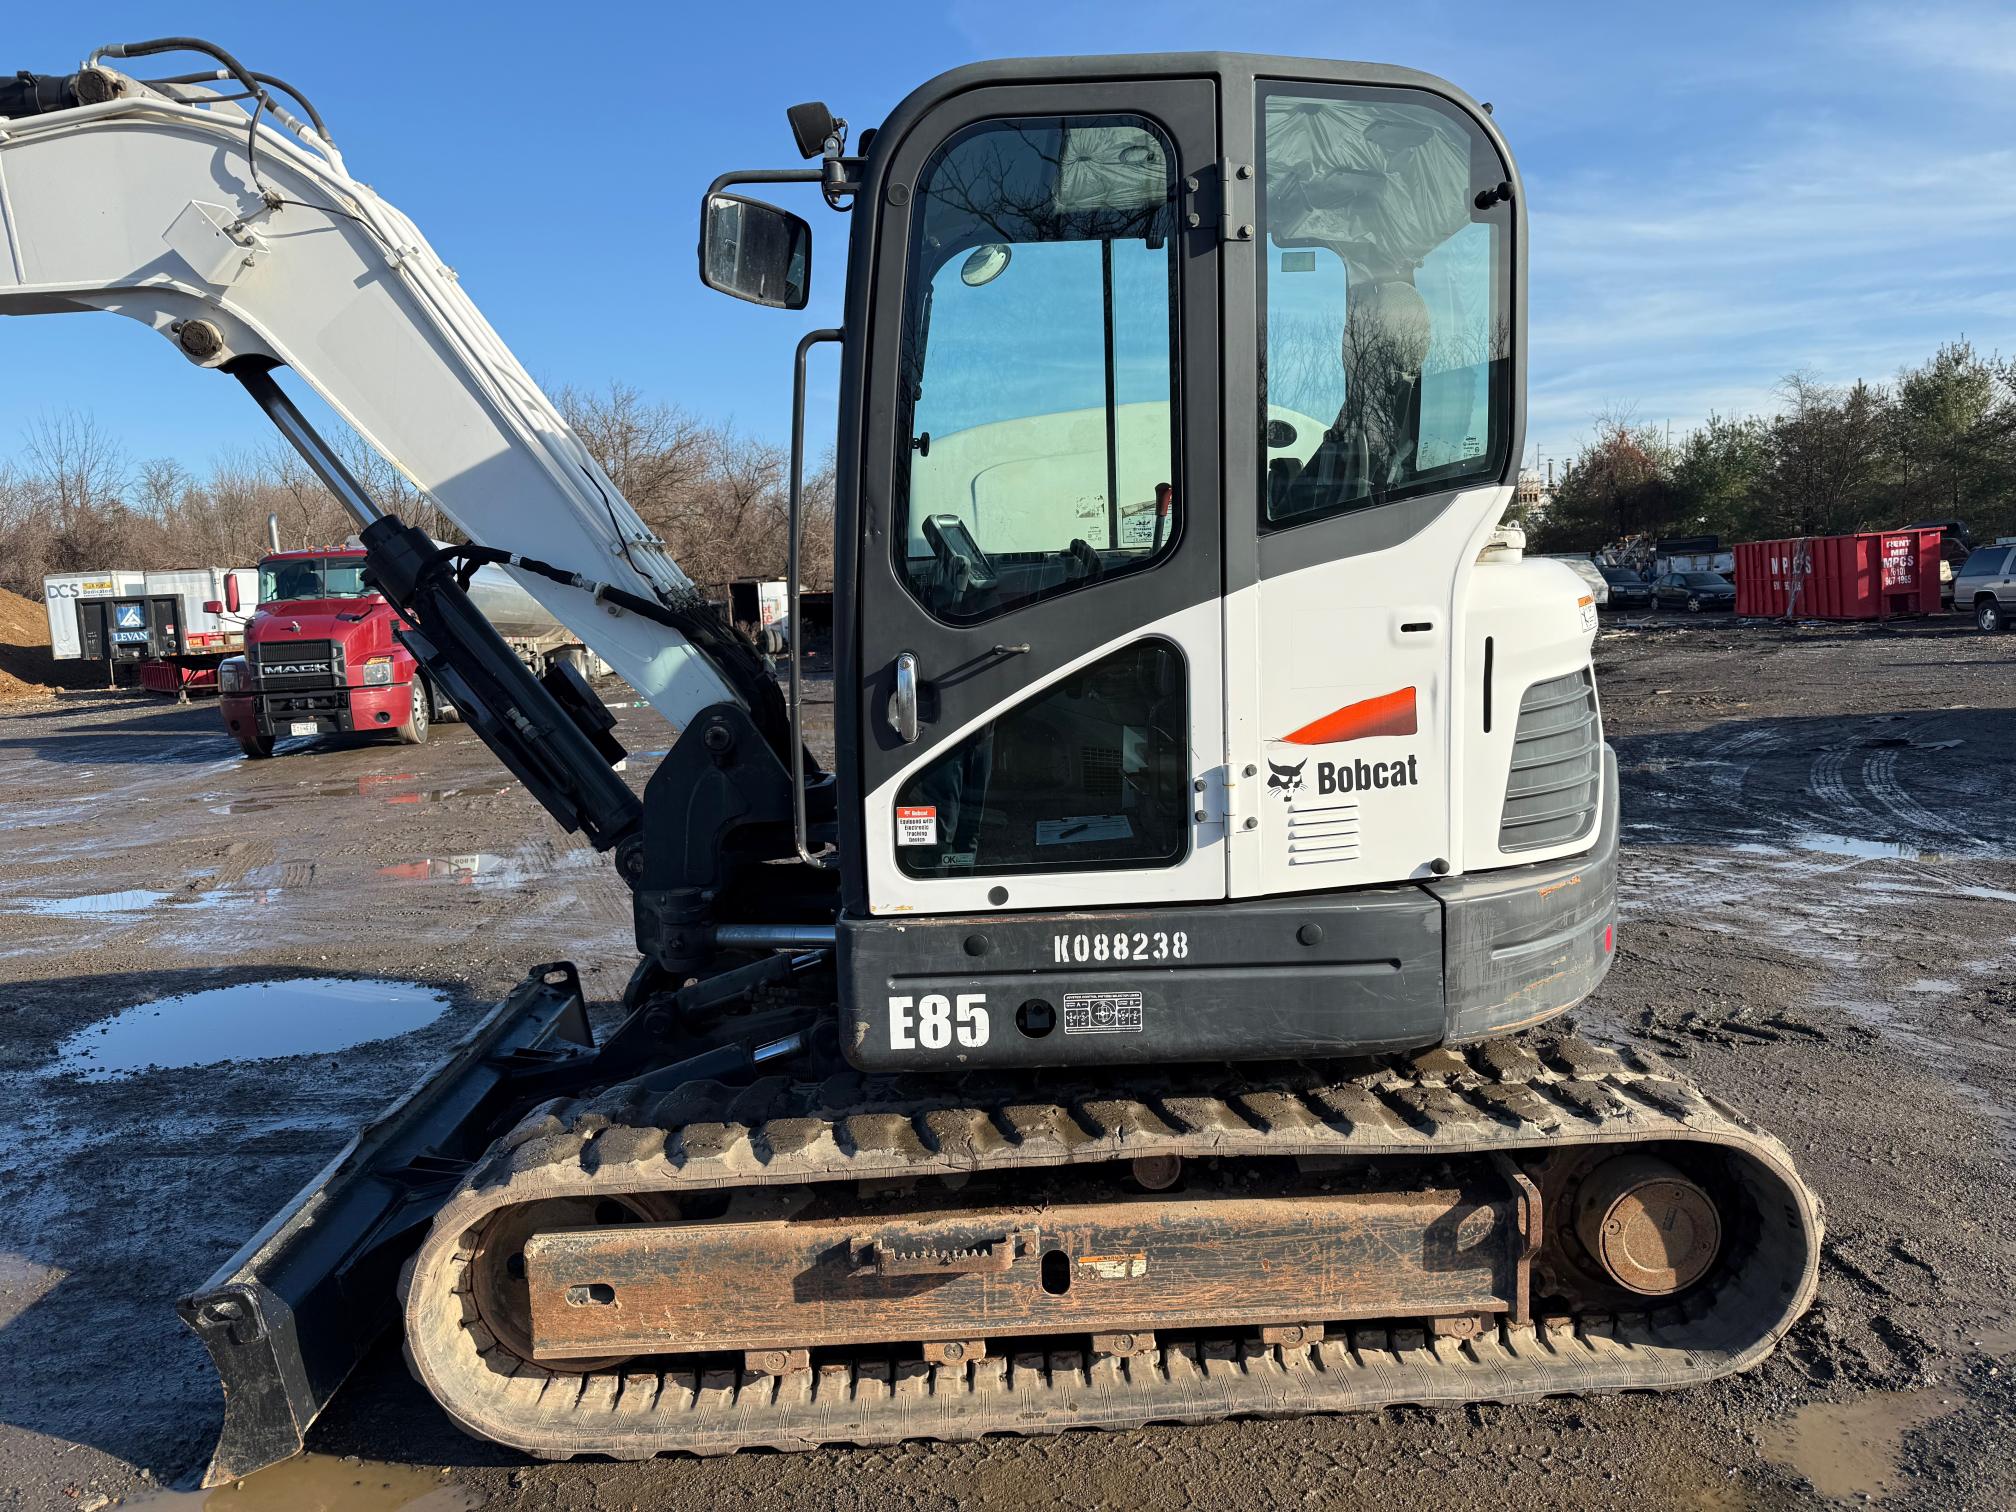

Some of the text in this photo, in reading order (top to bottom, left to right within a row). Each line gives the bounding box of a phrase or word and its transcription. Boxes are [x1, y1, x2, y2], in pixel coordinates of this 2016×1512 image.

[1886, 539, 1911, 548] RENT
[1883, 555, 1914, 568] MPCS
[46, 583, 79, 599] DCS
[114, 631, 148, 641] LEVAN
[264, 663, 330, 674] MACK
[1318, 754, 1418, 795] Bobcat
[942, 855, 956, 864] OK
[1054, 931, 1189, 963] K088238
[888, 993, 990, 1050] E85
